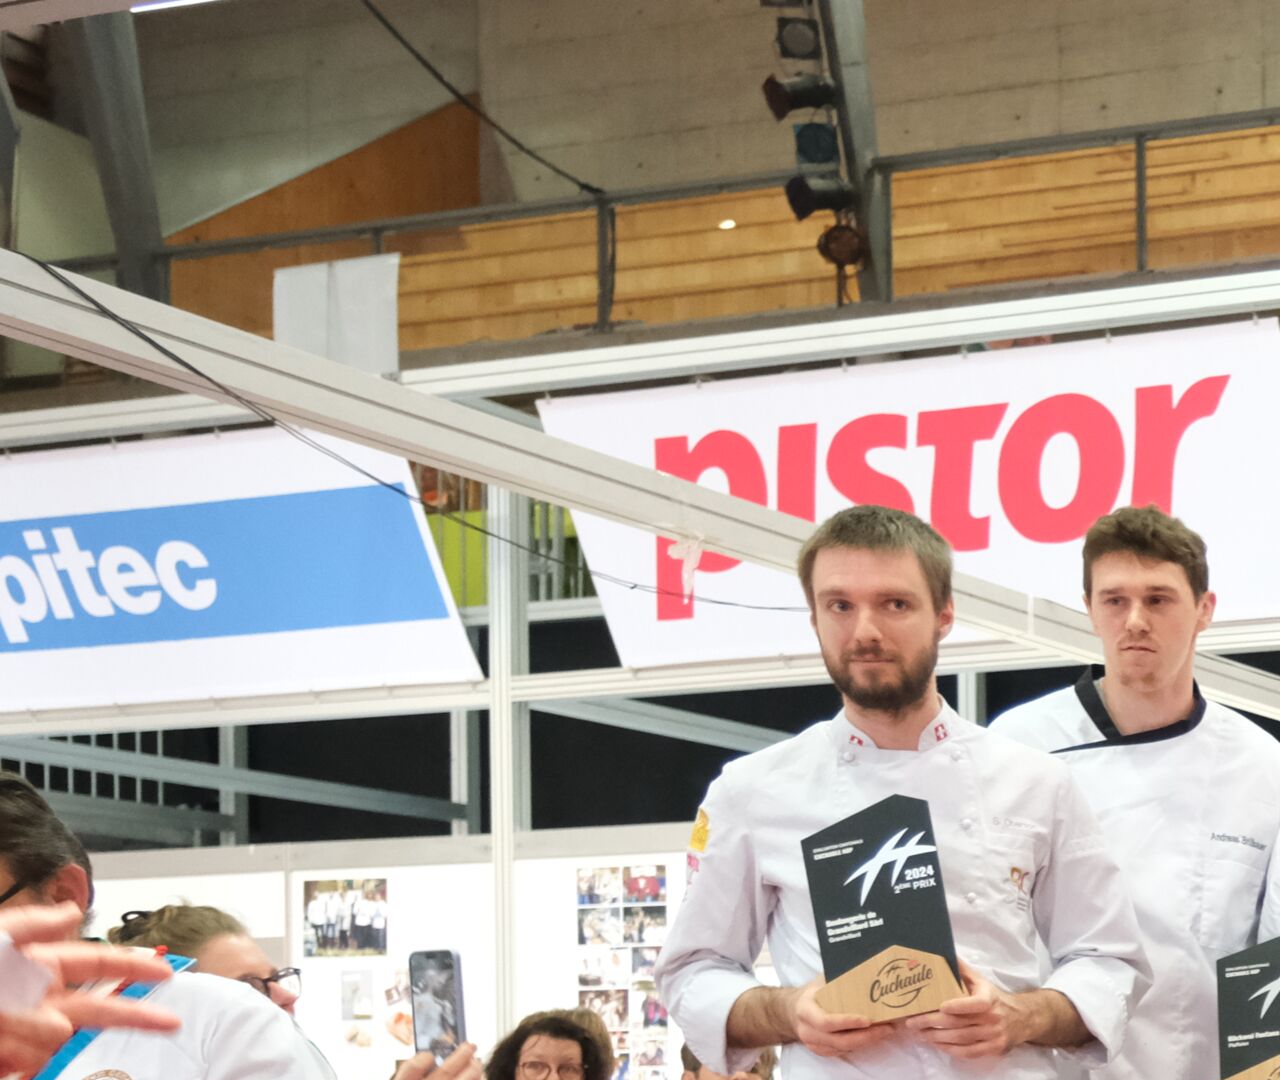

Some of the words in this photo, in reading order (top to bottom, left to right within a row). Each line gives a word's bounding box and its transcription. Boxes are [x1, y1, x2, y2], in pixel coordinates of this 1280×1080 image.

[0, 526, 218, 644] pitec
[905, 865, 934, 880] 2024
[913, 878, 936, 890] PRIX
[870, 965, 934, 1004] Cuchaule
